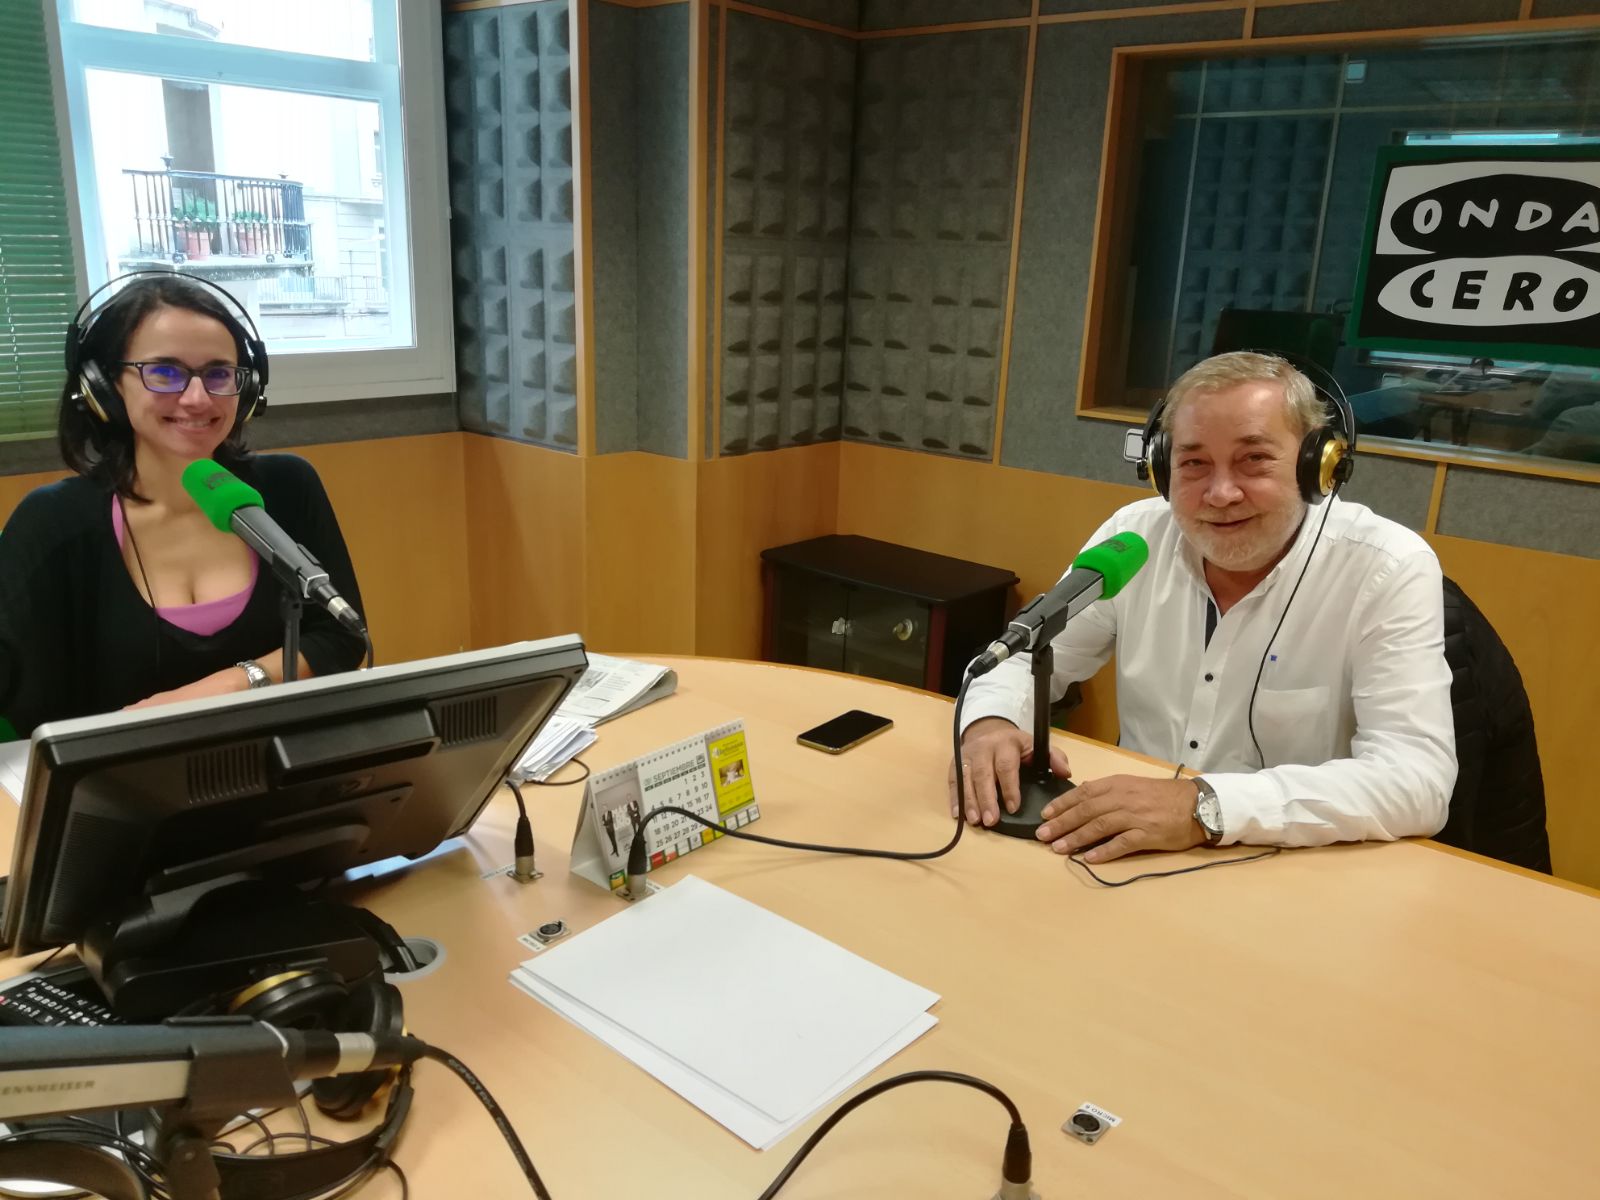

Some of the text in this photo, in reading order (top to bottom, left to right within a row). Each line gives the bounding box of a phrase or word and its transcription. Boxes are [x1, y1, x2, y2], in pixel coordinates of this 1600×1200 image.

[1412, 198, 1599, 235] ONDA
[1409, 269, 1589, 313] CERO
[652, 759, 695, 783] SEPTIEMBRE
[685, 789, 690, 797] 8
[694, 785, 699, 793] 9
[701, 781, 709, 790] 10
[687, 800, 694, 808] 15
[695, 796, 702, 804] 16
[703, 792, 710, 800] 17
[654, 827, 661, 836] 18
[663, 823, 670, 831] 19
[671, 819, 679, 828] 20
[680, 815, 687, 823] 21
[697, 807, 704, 816] 23
[705, 803, 713, 812] 24
[656, 839, 664, 848] 25
[665, 835, 673, 843] 26
[674, 830, 681, 839] 27
[682, 827, 690, 836] 28
[691, 823, 698, 831] 29
[2, 1080, 96, 1096] ENNHEISER
